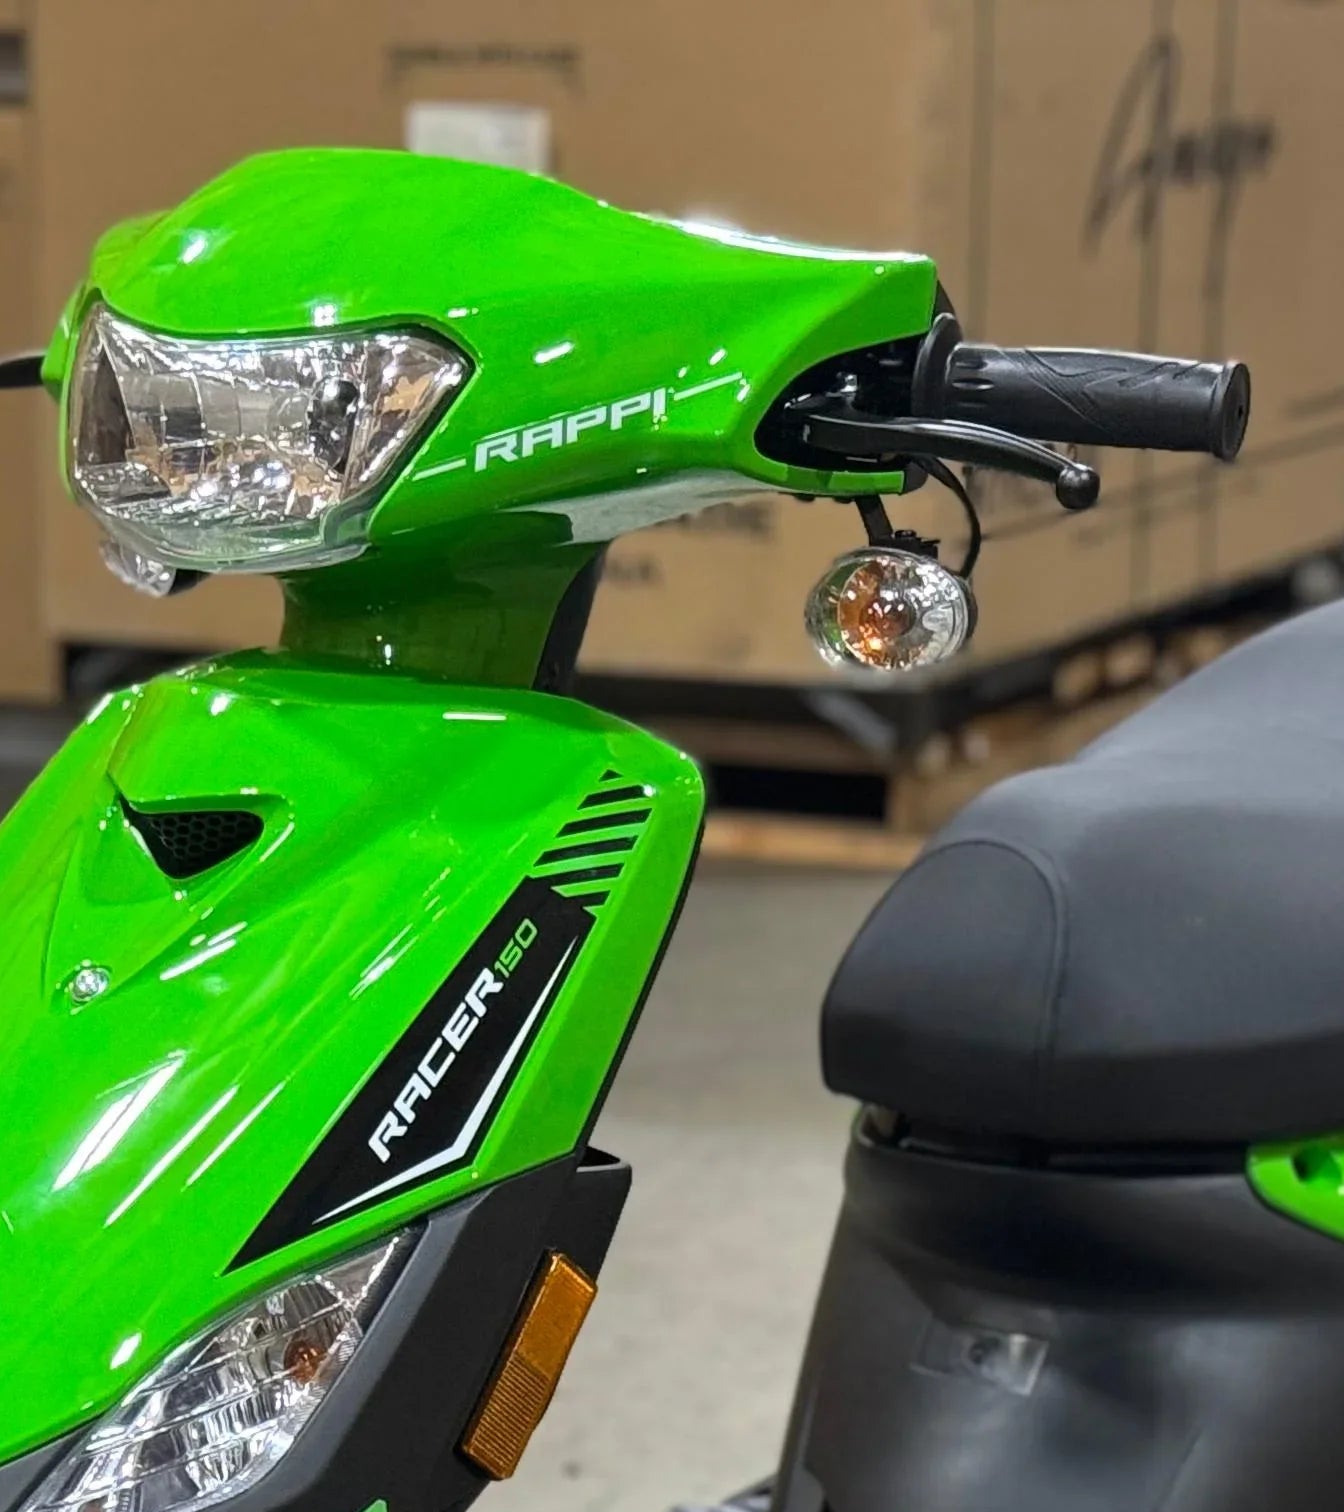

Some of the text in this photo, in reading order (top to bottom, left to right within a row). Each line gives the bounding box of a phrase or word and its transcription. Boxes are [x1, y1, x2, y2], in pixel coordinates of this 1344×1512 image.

[474, 387, 667, 473] RAPPI
[368, 917, 539, 1164] RACER 150
